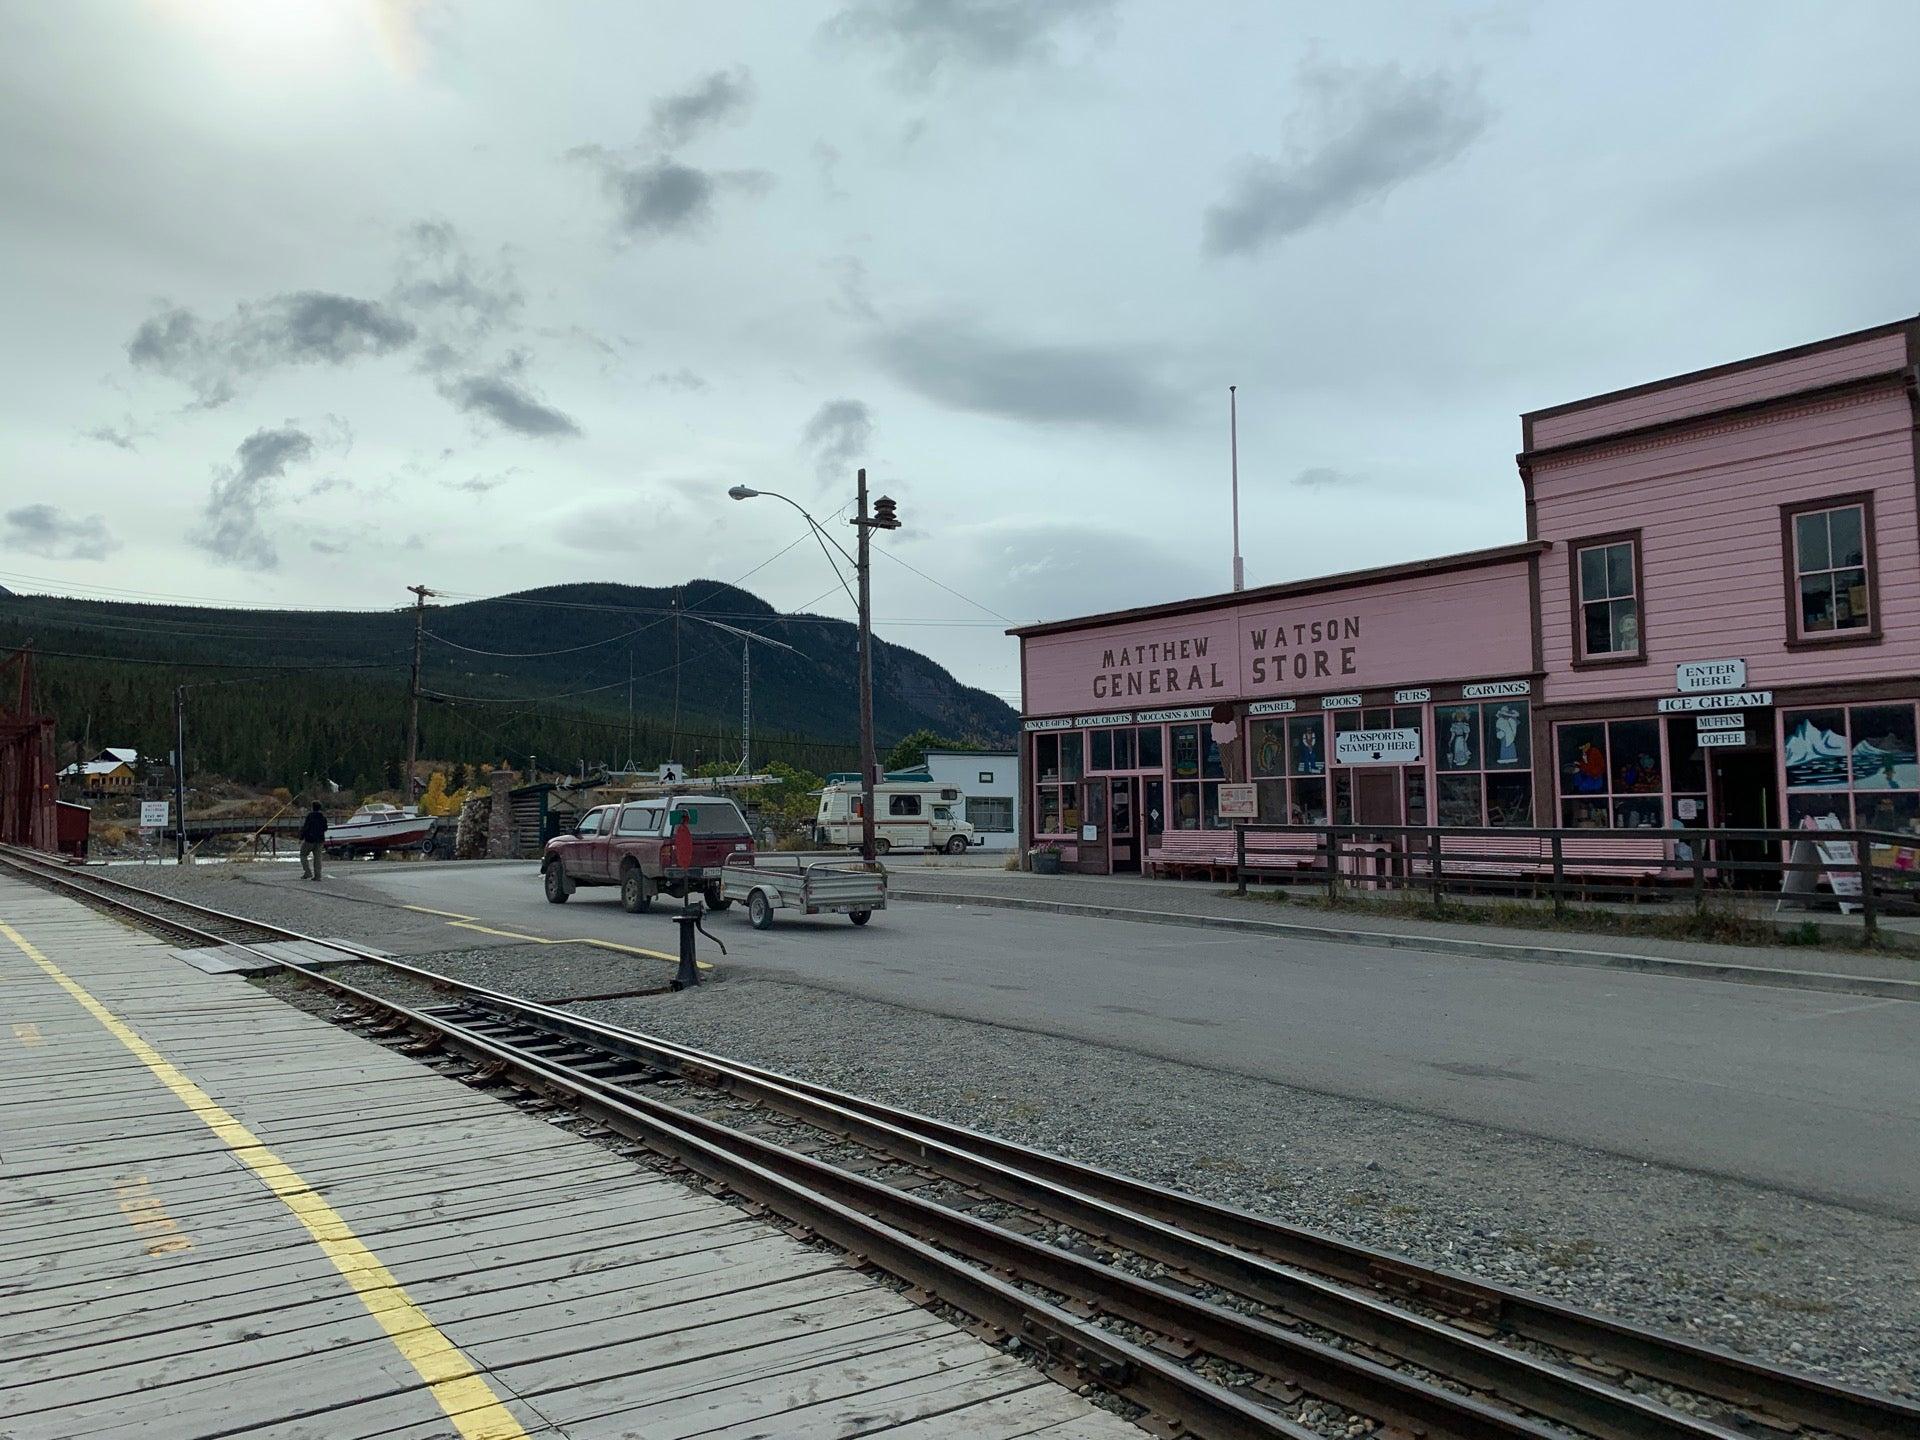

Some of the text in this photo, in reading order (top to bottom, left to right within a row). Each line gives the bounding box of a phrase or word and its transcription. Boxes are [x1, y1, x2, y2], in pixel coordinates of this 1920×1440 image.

[1102, 615, 1360, 668] MATTHEW WATSON
[1093, 646, 1357, 699] GENERAL STORE
[1685, 664, 1736, 677] ENTER
[1690, 675, 1732, 687] HERE
[1466, 683, 1527, 696] CARVINGS
[1325, 696, 1359, 707] BOOKS
[1399, 691, 1428, 701] FURS
[1665, 693, 1765, 711] ICE CREAM
[1252, 702, 1293, 713] APPAREL
[1077, 714, 1131, 726] LOCAL CRAFTS
[1139, 710, 1182, 721] MOCCASINS
[1700, 715, 1742, 727] MUFFINS
[1027, 719, 1070, 730] UNIQUE GIFTS
[1349, 731, 1405, 742] PASSPORTS
[1702, 733, 1742, 744] COFFEE
[1339, 741, 1416, 753] STAMPED HERE
